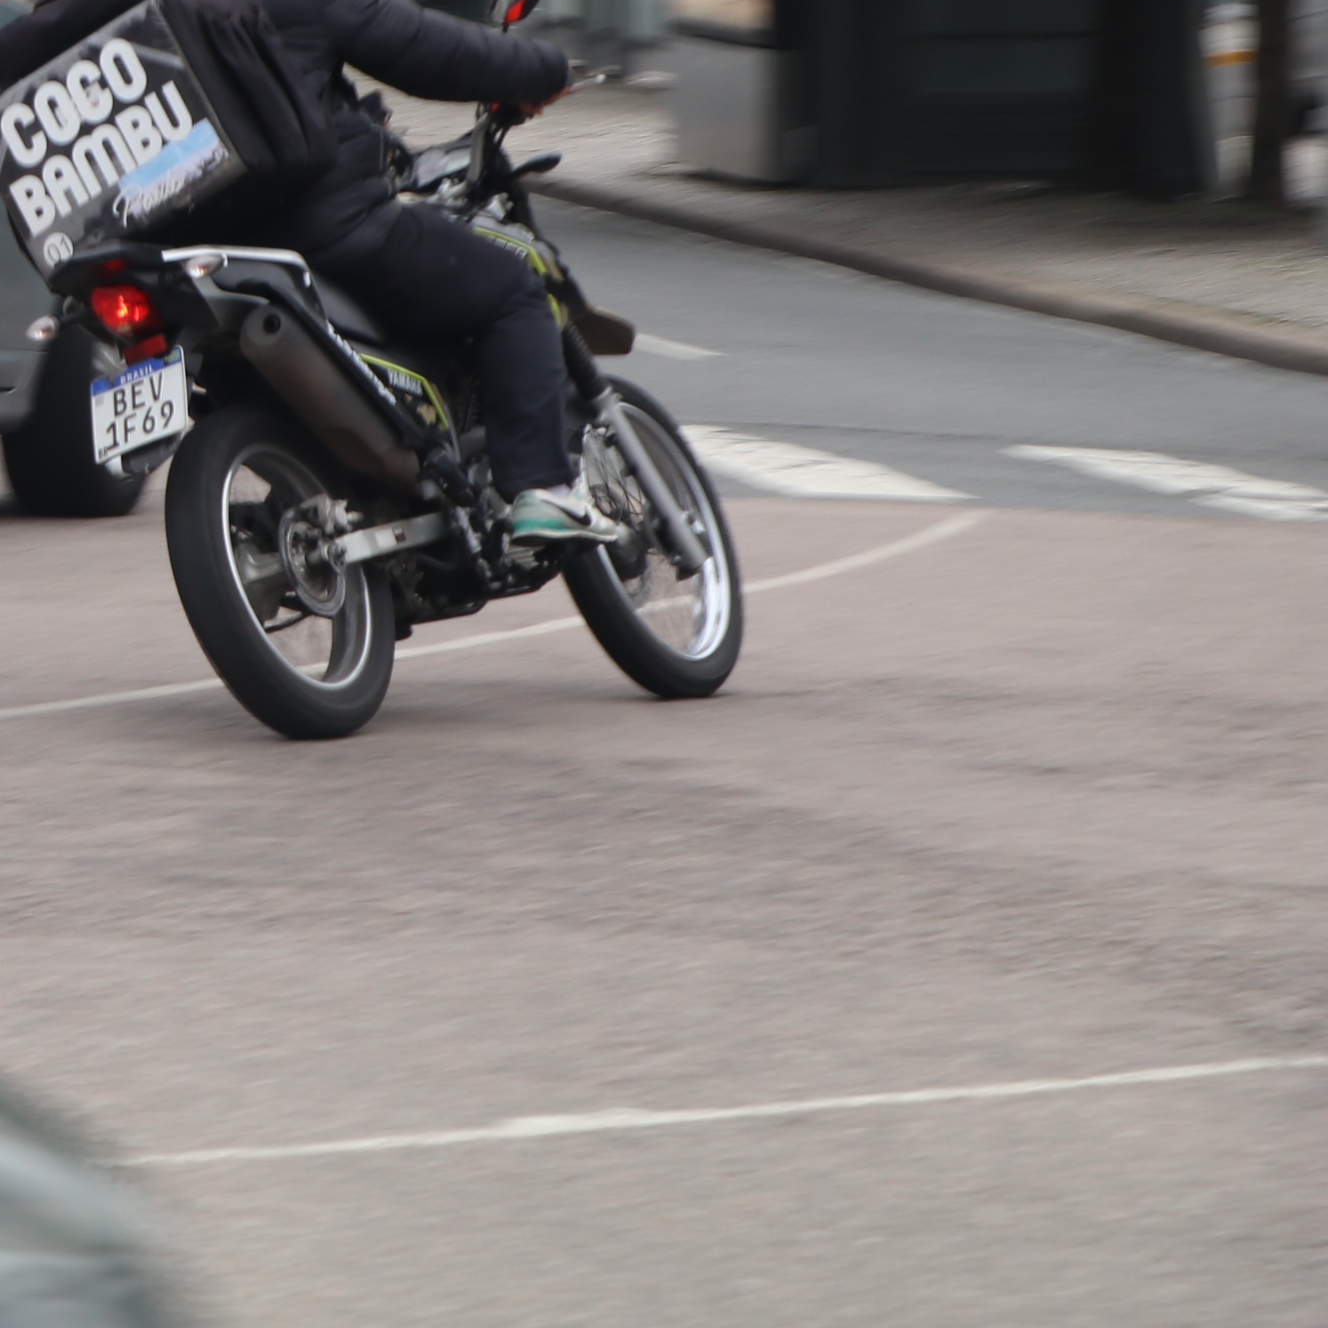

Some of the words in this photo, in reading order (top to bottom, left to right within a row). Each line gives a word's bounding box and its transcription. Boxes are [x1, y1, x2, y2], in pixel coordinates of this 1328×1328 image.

[0, 37, 147, 168] COCO
[9, 79, 193, 238] BAMBU
[113, 371, 163, 418] BEV
[120, 363, 155, 385] BRASIL
[106, 399, 175, 451] 1F69
